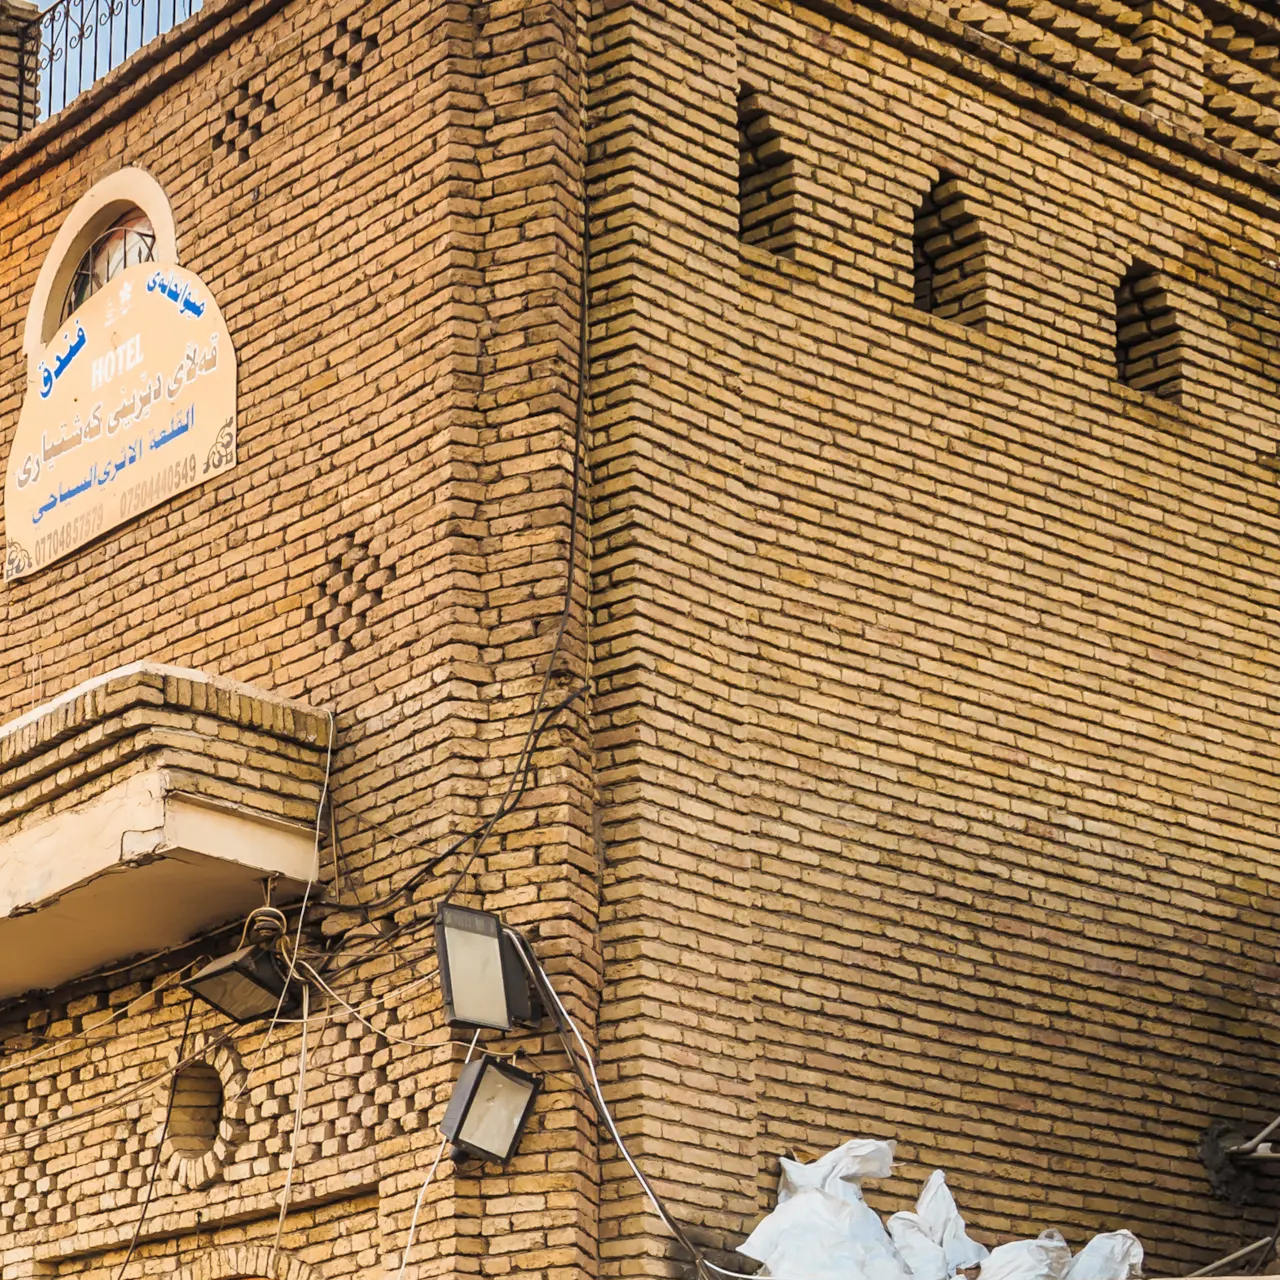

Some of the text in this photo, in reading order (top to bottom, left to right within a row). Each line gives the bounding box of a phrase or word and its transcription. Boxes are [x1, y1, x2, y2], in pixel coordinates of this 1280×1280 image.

[39, 319, 86, 399] فندق
[91, 334, 144, 391] HOTEL
[150, 402, 195, 450] القلعة
